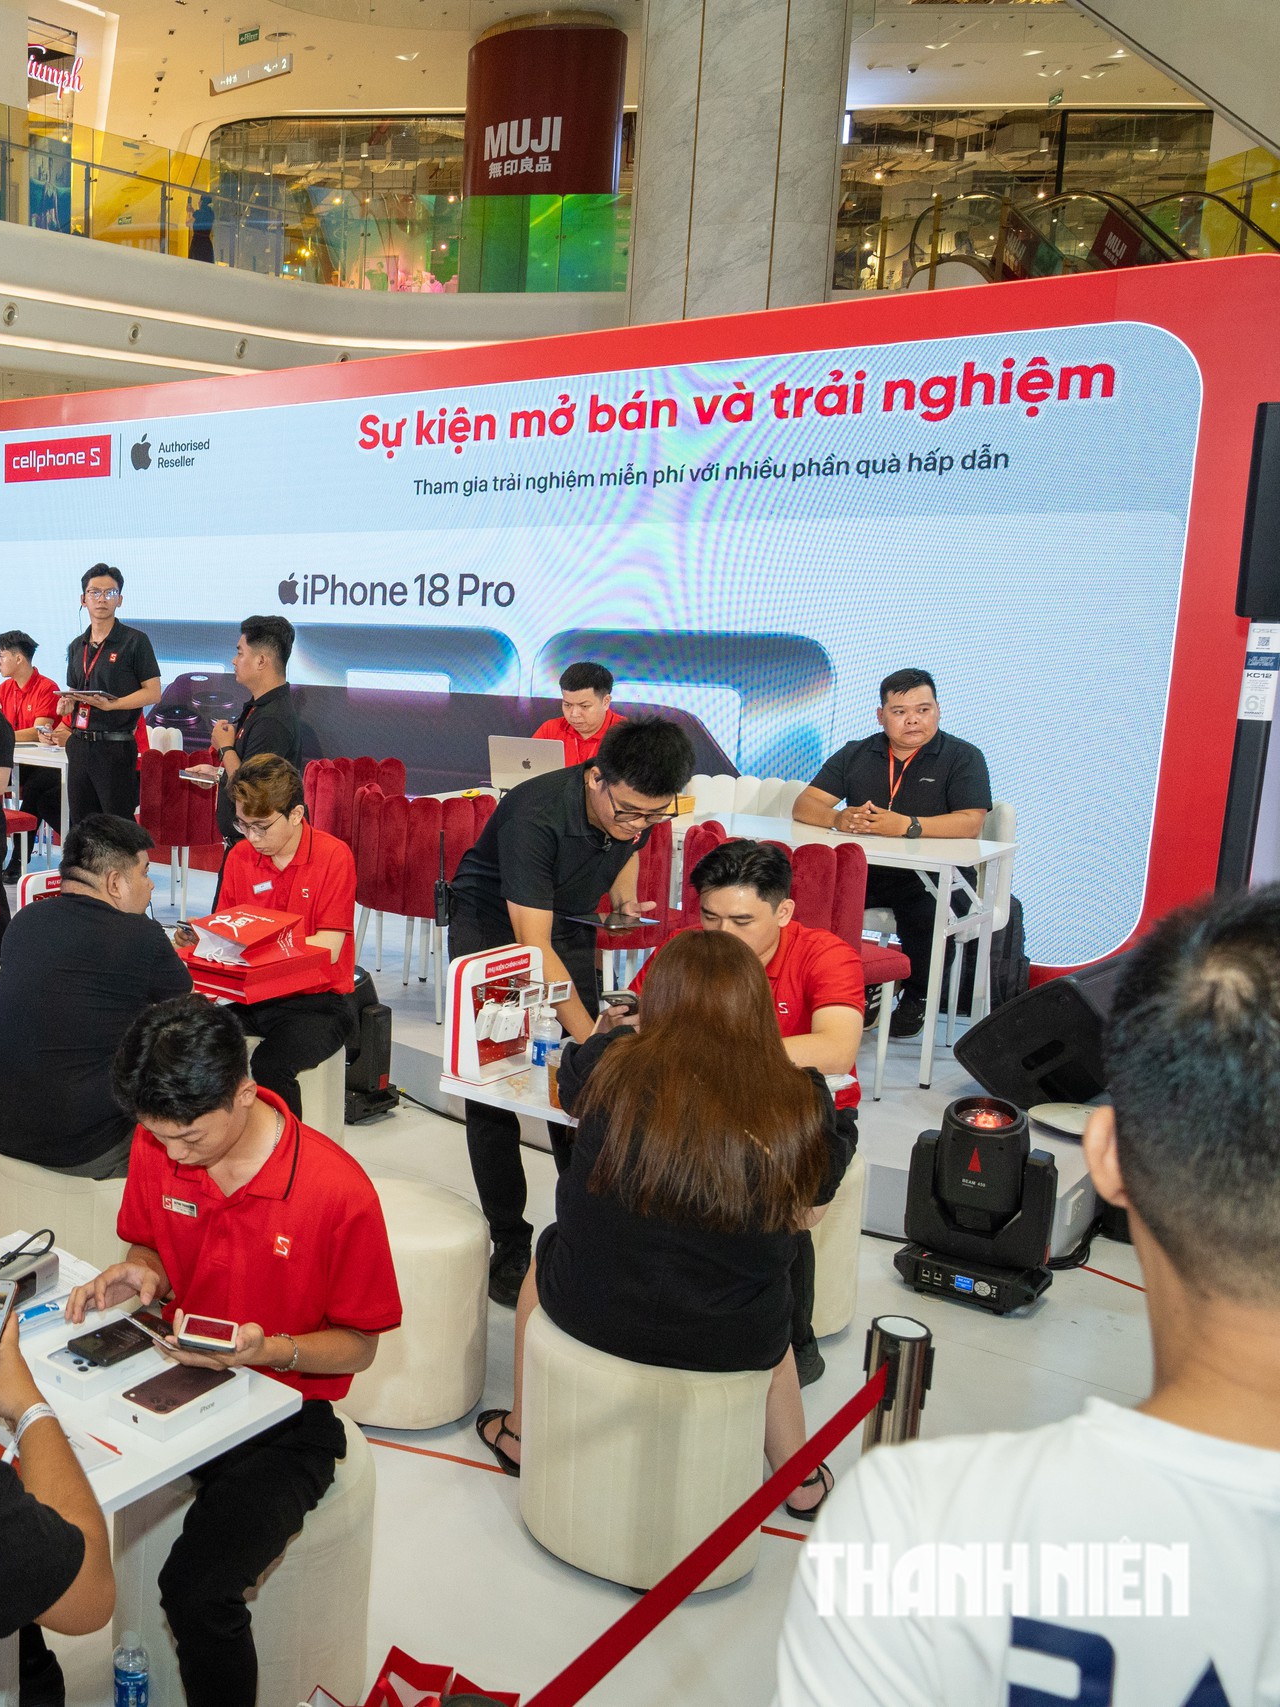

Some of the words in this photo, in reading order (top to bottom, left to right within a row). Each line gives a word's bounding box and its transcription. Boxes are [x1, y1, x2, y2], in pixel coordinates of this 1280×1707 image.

[28, 43, 83, 100] iumph
[484, 116, 562, 161] MUJI
[488, 156, 552, 179] 無印良品
[1104, 231, 1128, 258] MUJI
[359, 413, 407, 459] Sự
[415, 406, 496, 454] kiện
[510, 394, 576, 438] mở
[589, 389, 677, 434] bán
[694, 381, 754, 426] và
[771, 369, 867, 420] trải
[882, 356, 1115, 423] nghiệm
[158, 439, 210, 454] Authorised
[157, 455, 195, 469] Reseller
[414, 478, 458, 496] Tham
[463, 475, 488, 497] gia
[492, 472, 521, 492] trải
[525, 469, 595, 494] nghiệm
[600, 463, 647, 487] miễn
[652, 464, 685, 488] phí
[690, 462, 719, 483] với
[725, 457, 786, 482] nhiều
[792, 451, 850, 482] phần
[855, 452, 901, 478] quà
[907, 447, 954, 476] hấp
[961, 443, 1009, 471] dẫn
[302, 573, 408, 606] iPhone
[413, 573, 449, 607] 18
[457, 573, 516, 607] Pro
[1245, 695, 1259, 711] 6
[199, 1401, 215, 1413] iPhone
